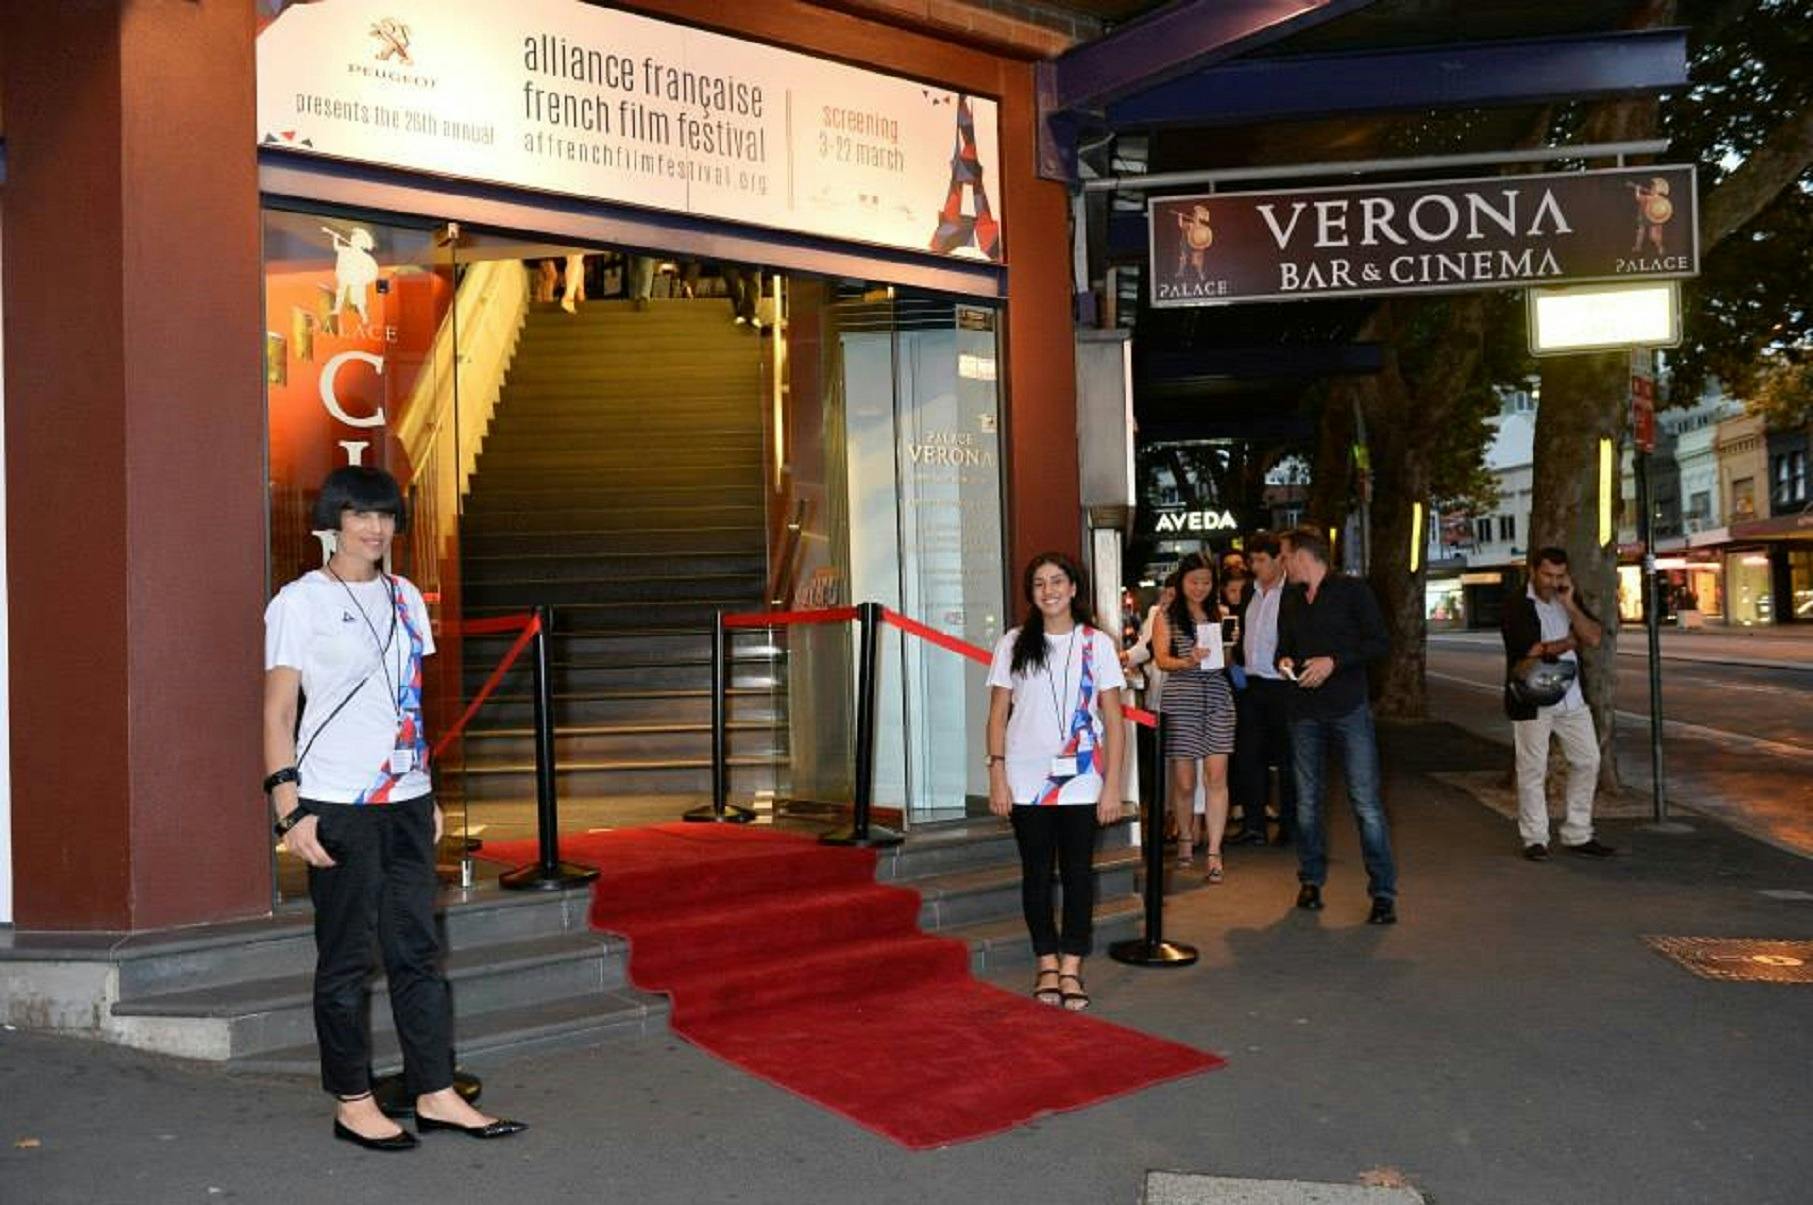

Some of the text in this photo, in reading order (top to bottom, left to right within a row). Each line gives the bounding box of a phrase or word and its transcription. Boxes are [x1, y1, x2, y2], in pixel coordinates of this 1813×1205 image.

[347, 63, 439, 88] PEUGEOT
[524, 34, 763, 119] alliance française
[295, 93, 370, 125] presents
[374, 105, 400, 129] the
[443, 119, 495, 145] annual
[523, 80, 766, 163] french film festival
[822, 105, 899, 144] screening
[855, 139, 905, 173] march
[1256, 187, 1573, 250] VERONA
[1279, 248, 1564, 291] BAR & CINEMA
[1616, 255, 1690, 273] PALACE
[1159, 280, 1228, 298] PALACE
[908, 444, 993, 469] VERONA
[1155, 510, 1238, 532] AVEDA
